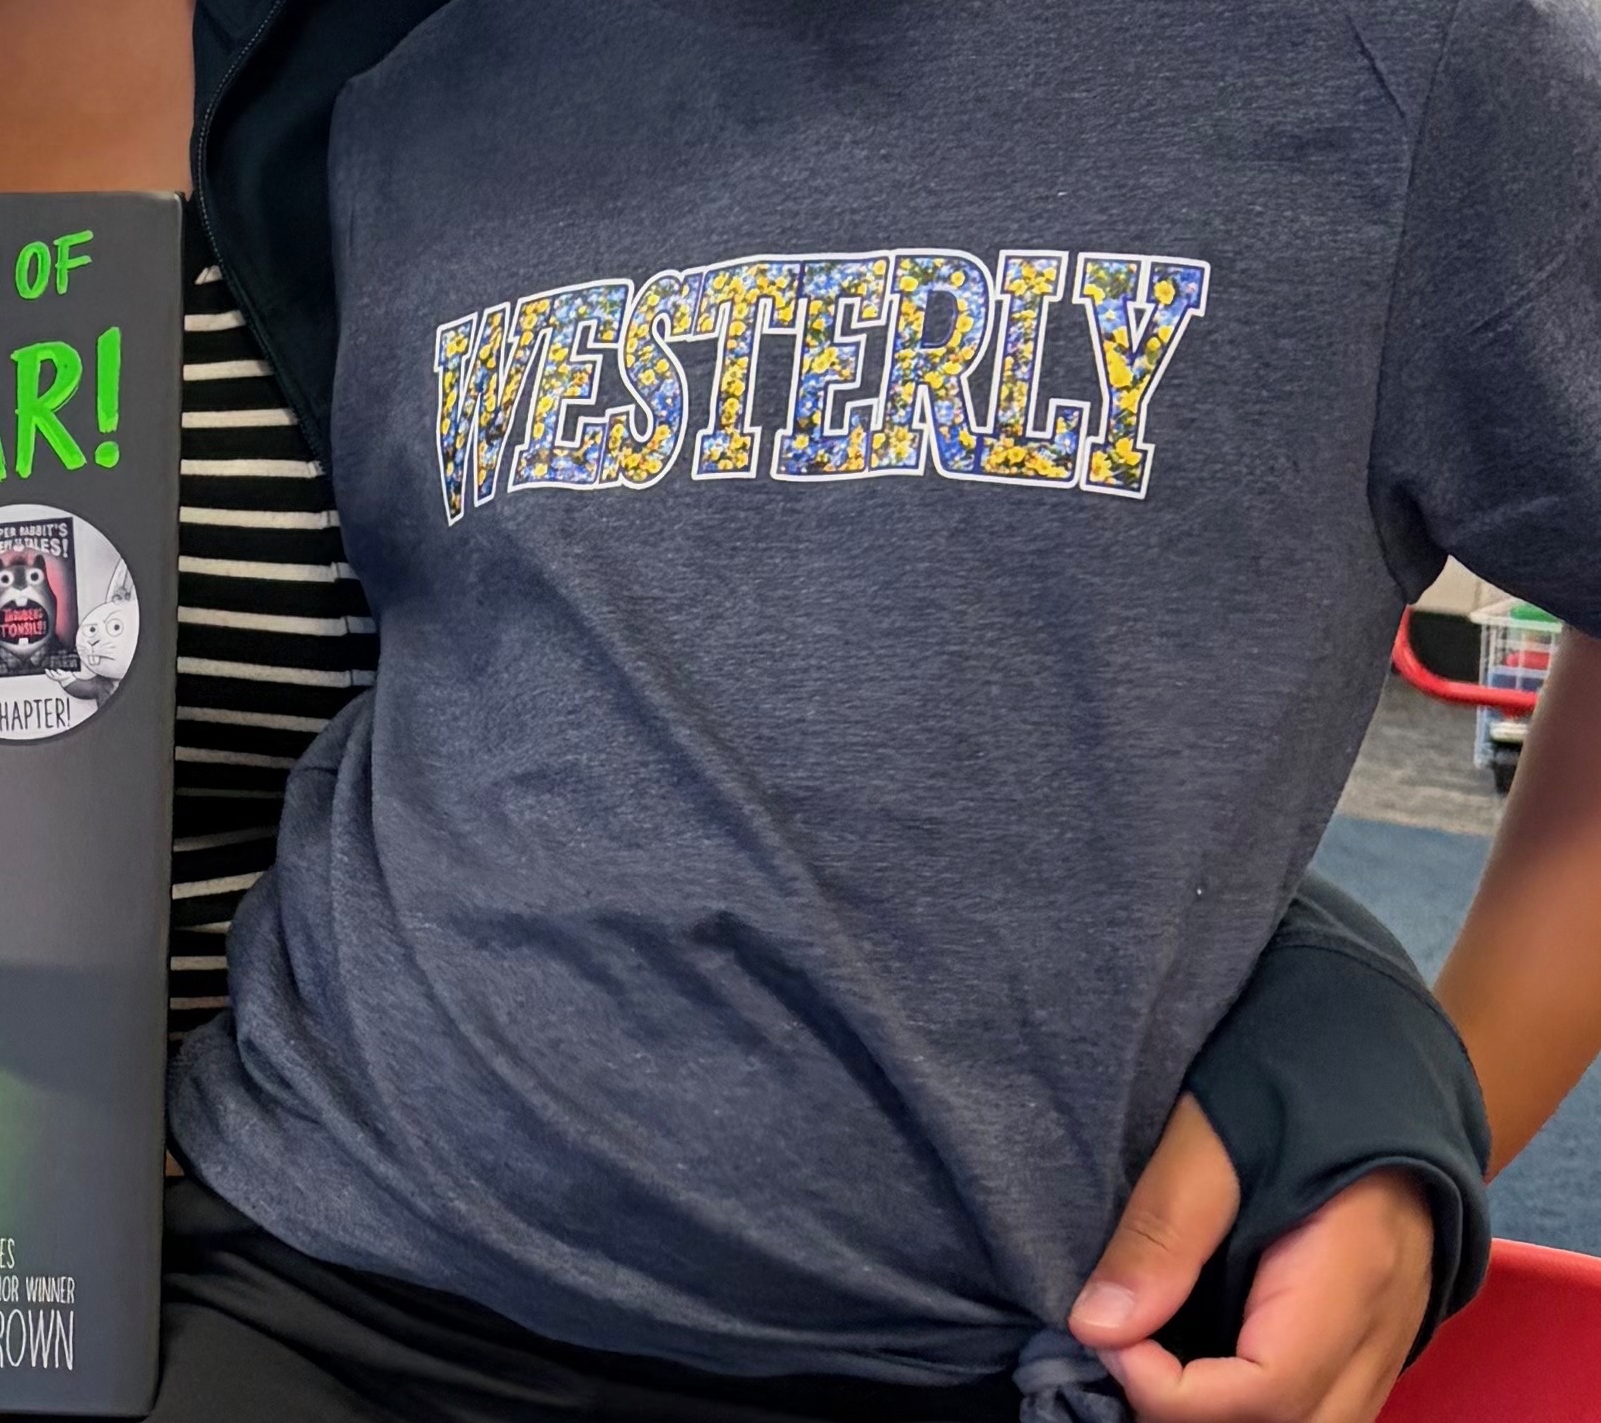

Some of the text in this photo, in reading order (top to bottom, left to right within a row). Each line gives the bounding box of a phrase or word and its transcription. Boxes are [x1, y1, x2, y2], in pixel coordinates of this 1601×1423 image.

[15, 230, 94, 300] OF
[435, 247, 1211, 527] WESTERLY
[24, 537, 69, 559] TALES!
[25, 1276, 76, 1304] WINNER
